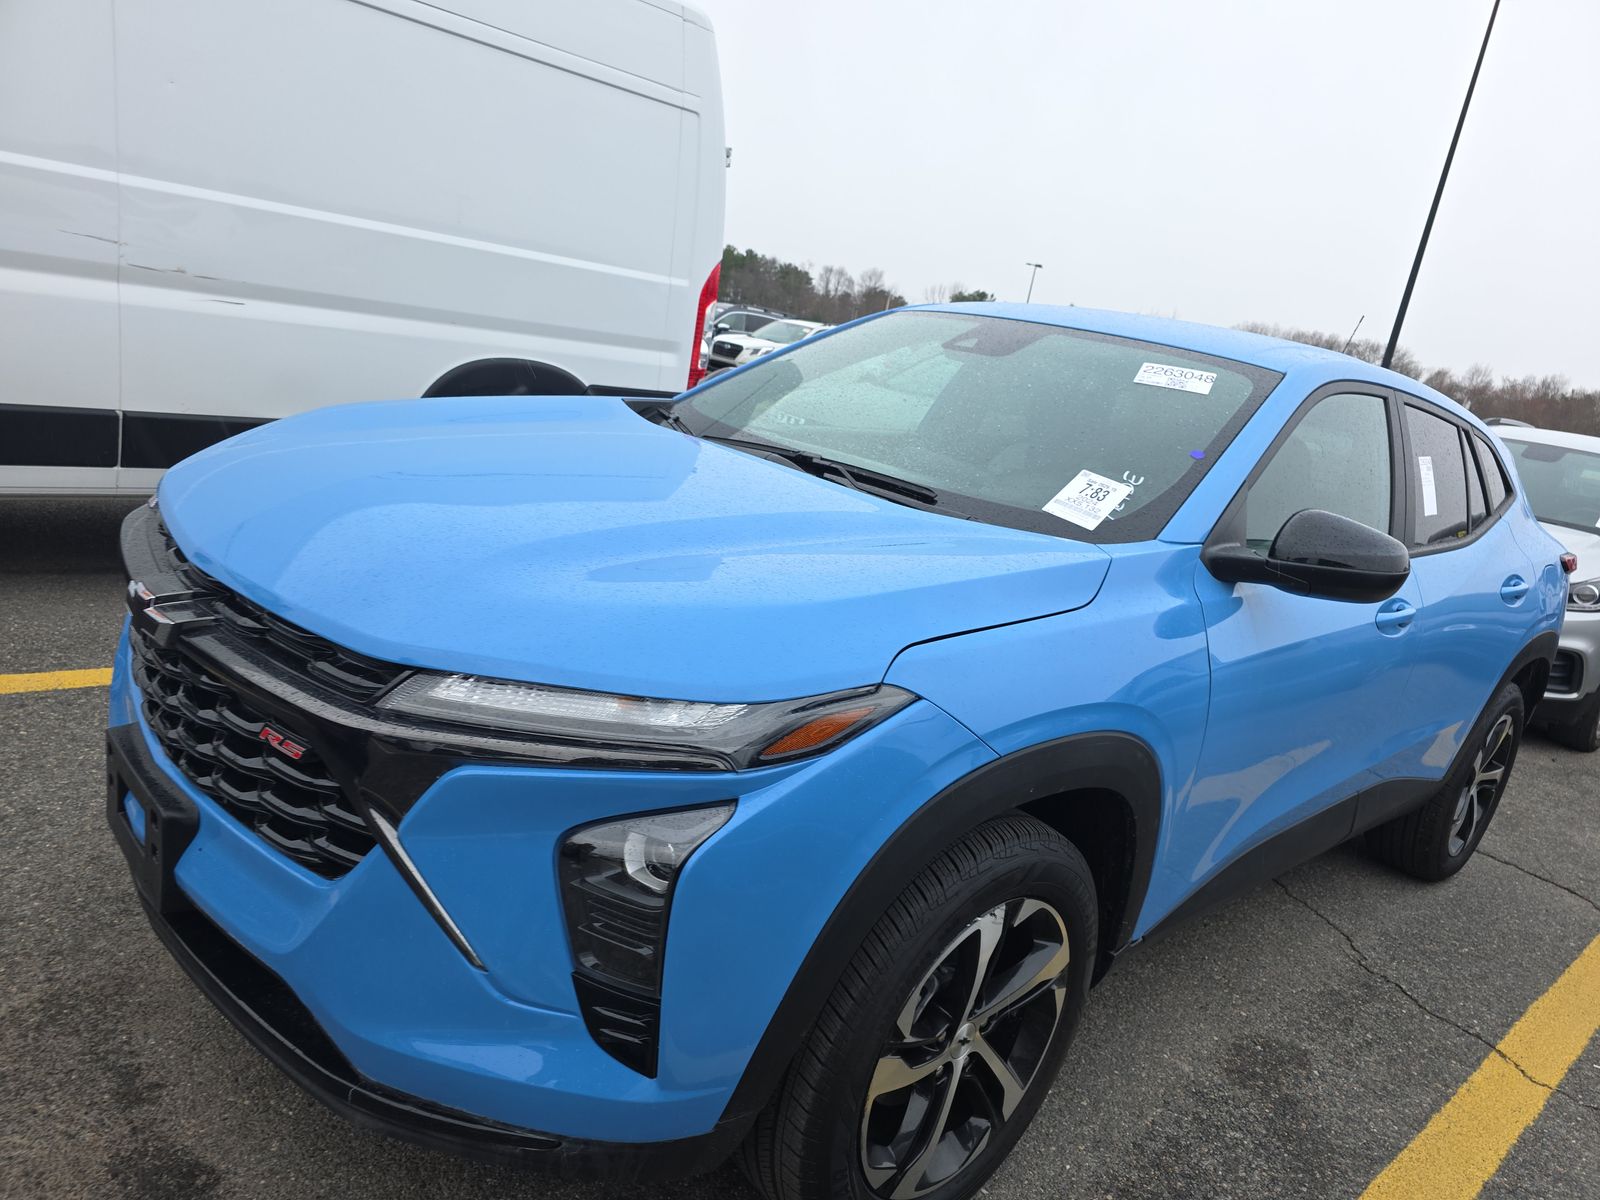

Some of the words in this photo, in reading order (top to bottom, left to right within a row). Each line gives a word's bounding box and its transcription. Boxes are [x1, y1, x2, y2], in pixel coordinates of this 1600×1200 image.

[1143, 365, 1216, 384] 2263048
[1079, 482, 1110, 502] 7:83
[259, 727, 307, 760] RS
